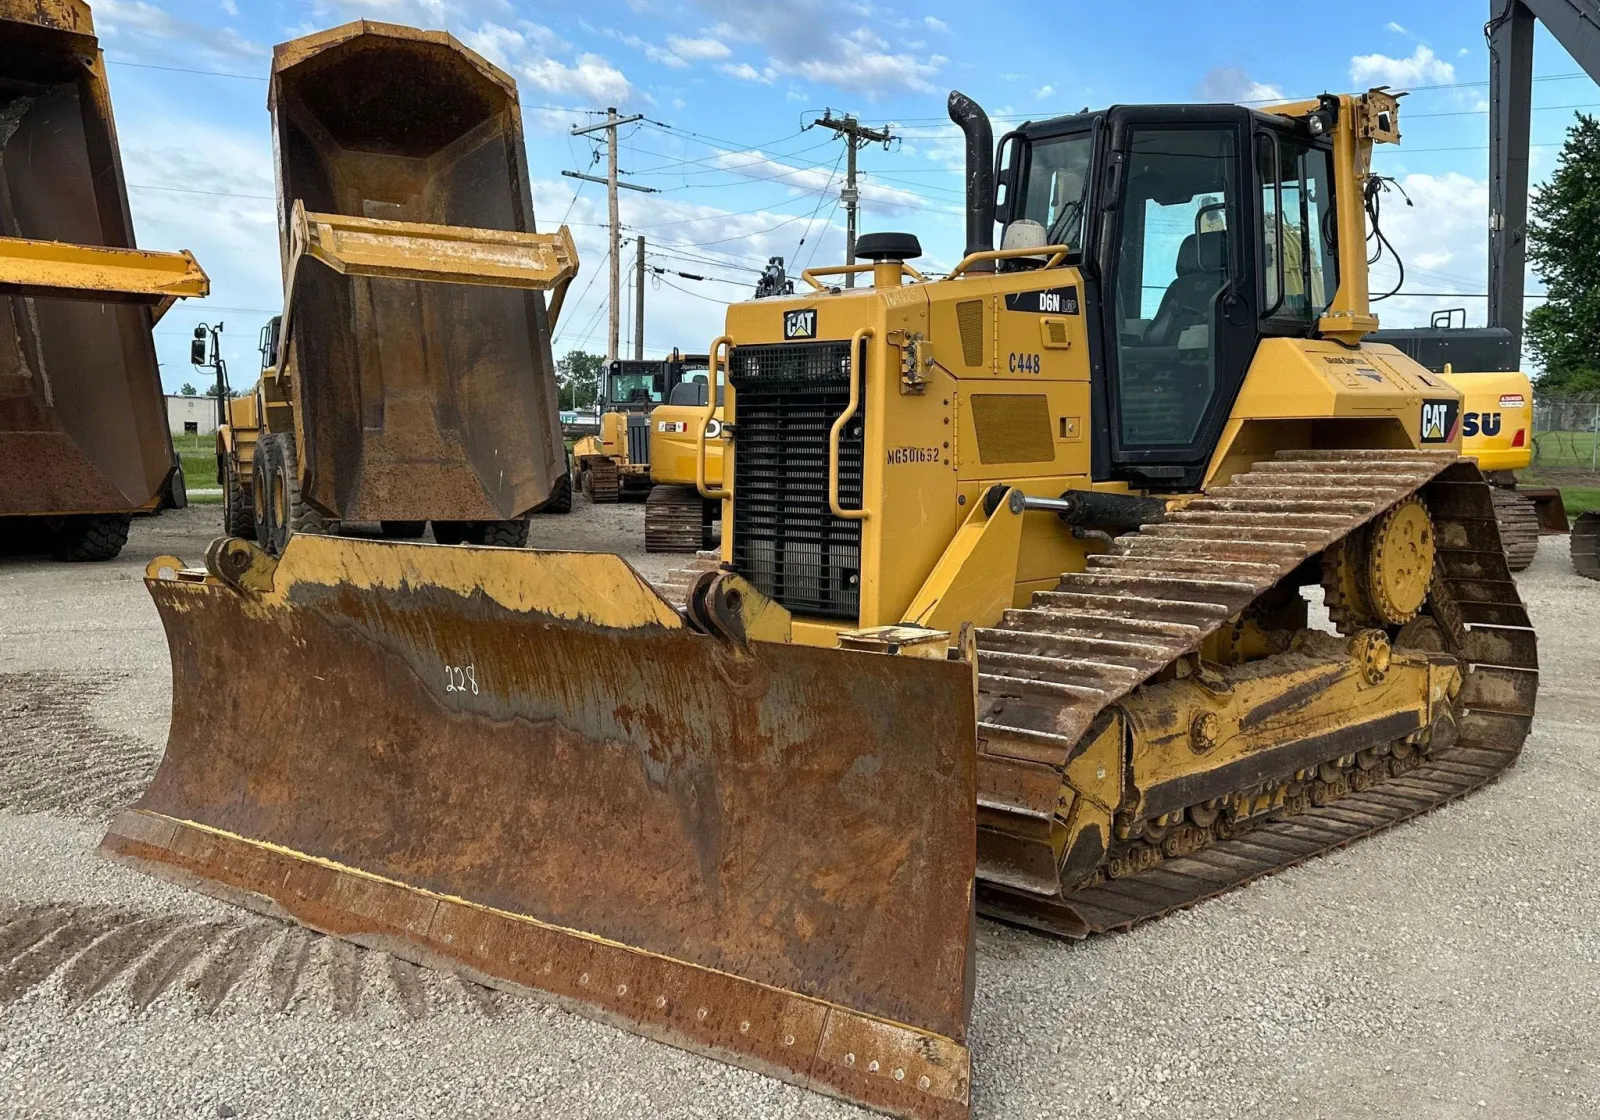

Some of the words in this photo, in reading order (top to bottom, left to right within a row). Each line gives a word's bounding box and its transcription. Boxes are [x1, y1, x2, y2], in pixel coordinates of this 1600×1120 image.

[1040, 293, 1060, 312] D6N
[786, 311, 814, 337] CAT
[1009, 352, 1040, 374] C448
[1422, 403, 1447, 438] CAT
[445, 662, 479, 695] 228
